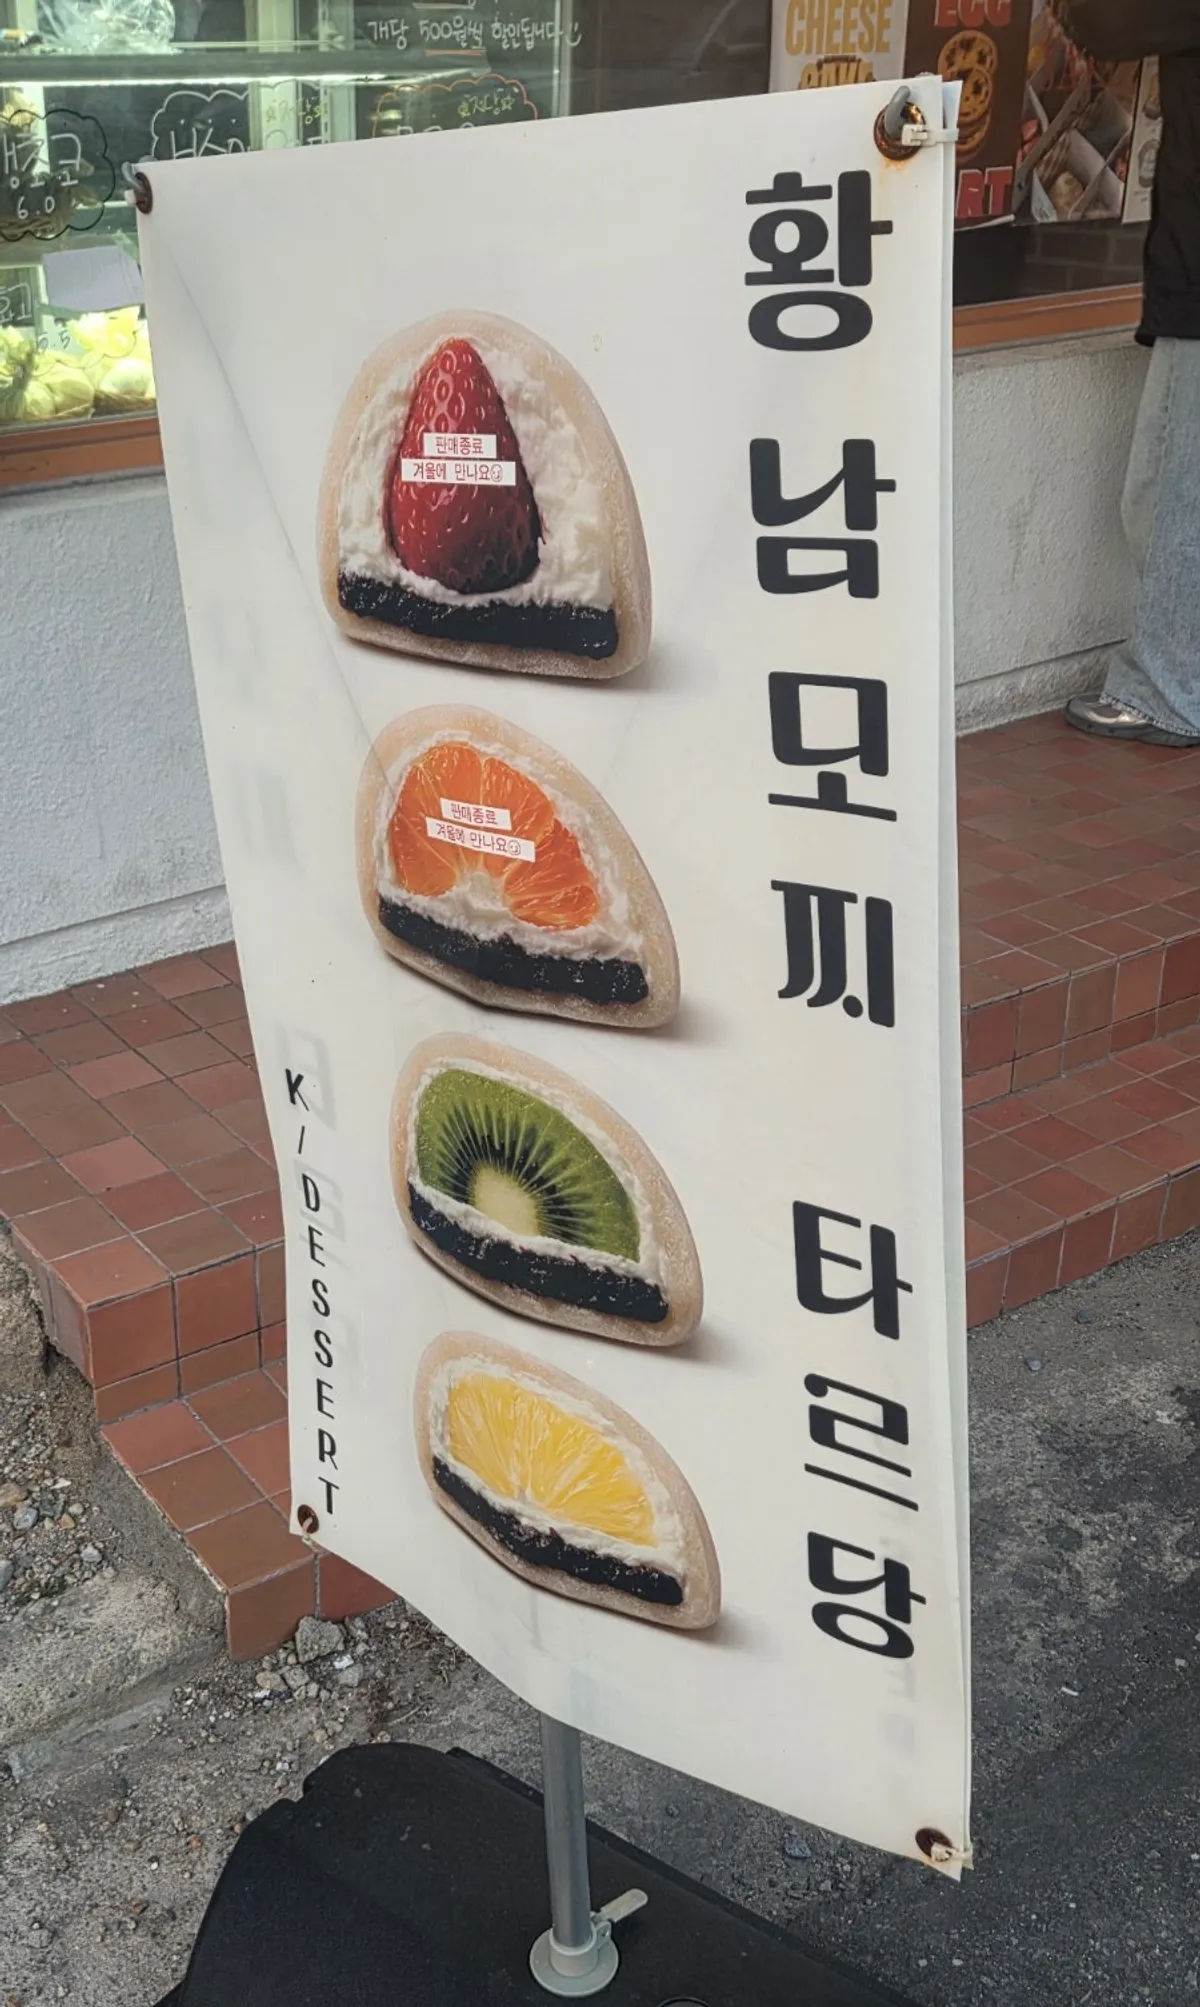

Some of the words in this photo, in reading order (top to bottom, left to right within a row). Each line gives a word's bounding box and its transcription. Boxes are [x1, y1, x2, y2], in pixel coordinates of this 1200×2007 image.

[367, 18, 410, 50] 개당
[785, 0, 891, 56] CHEESE
[17, 195, 55, 219] 6.0
[955, 166, 1013, 218] RT
[435, 436, 484, 456] 판매종료
[412, 462, 447, 481] 겨울에
[454, 463, 491, 482] 만나요
[747, 172, 897, 1028] 황남모찌
[450, 803, 498, 825] 판매종료
[435, 823, 466, 844] 겨울에
[469, 832, 508, 853] 만나요
[794, 1202, 926, 1659] 타르당
